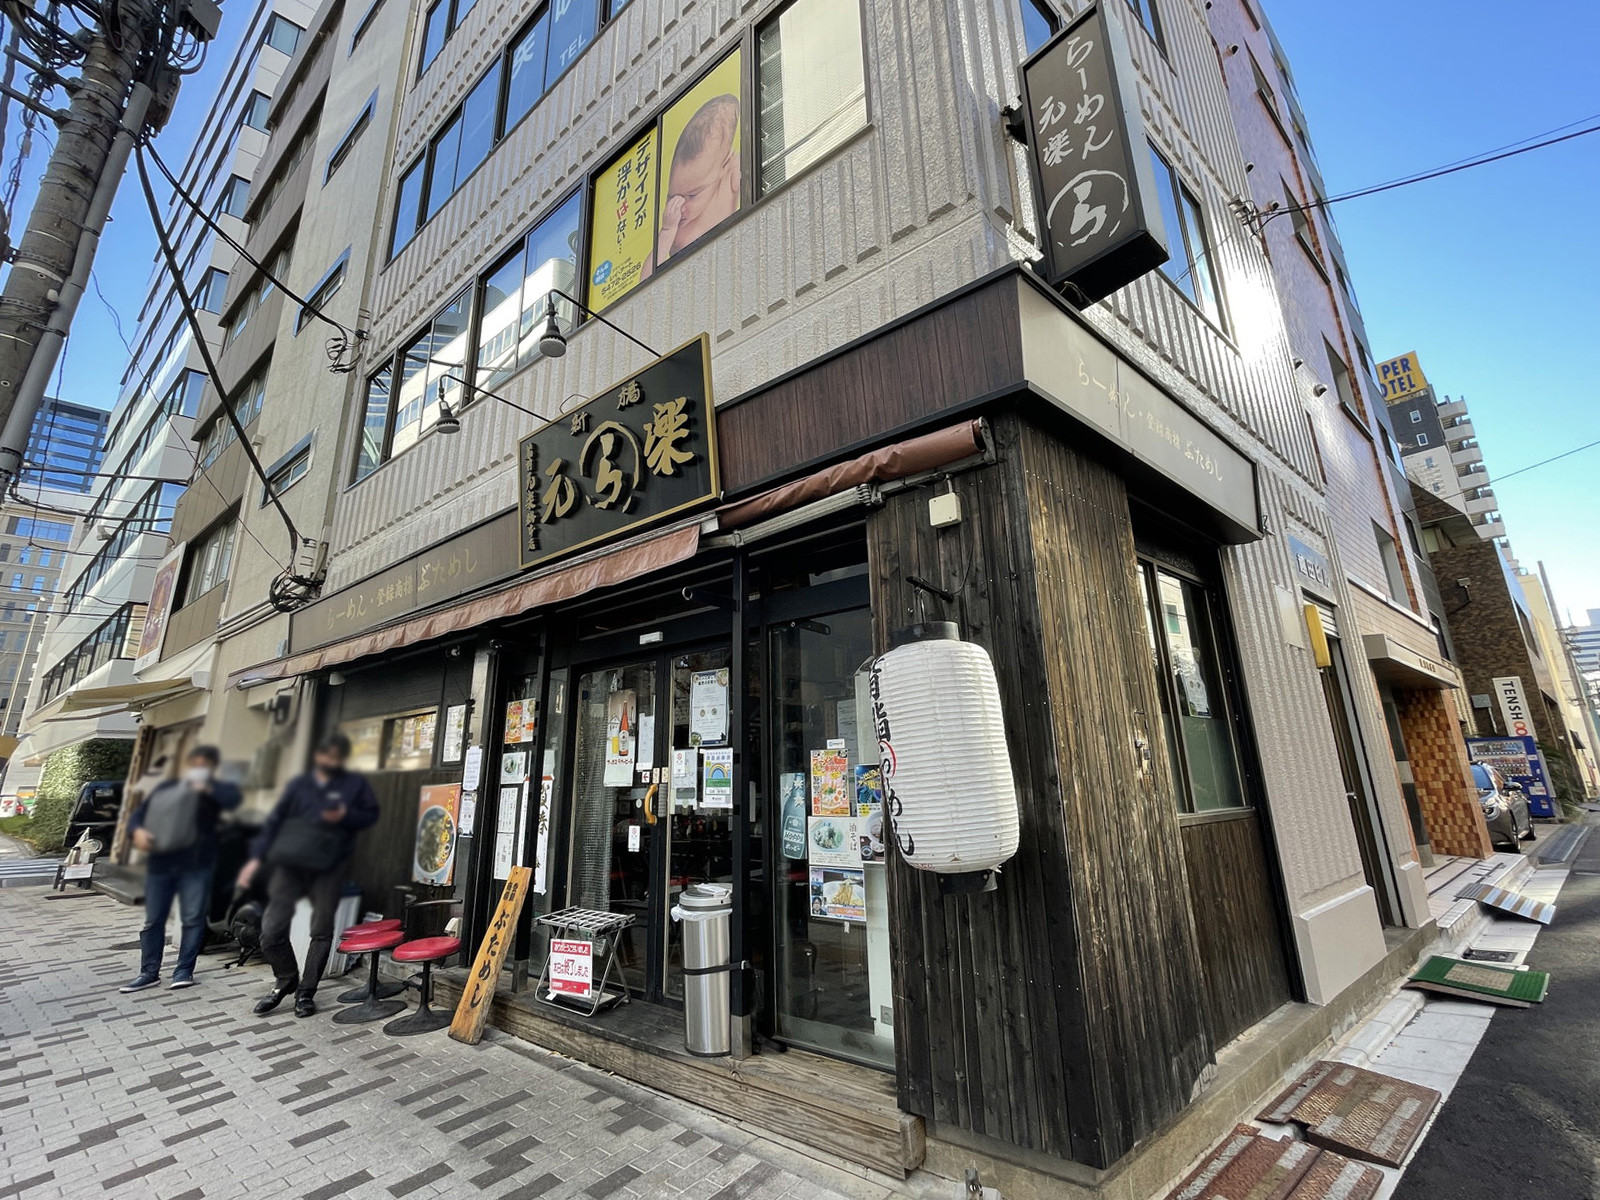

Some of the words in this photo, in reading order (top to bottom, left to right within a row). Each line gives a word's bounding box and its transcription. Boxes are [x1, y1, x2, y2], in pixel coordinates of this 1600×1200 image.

[560, 34, 587, 67] TEL
[1066, 36, 1114, 160] らーめん
[634, 134, 652, 231] デザインが
[1382, 357, 1411, 380] PER
